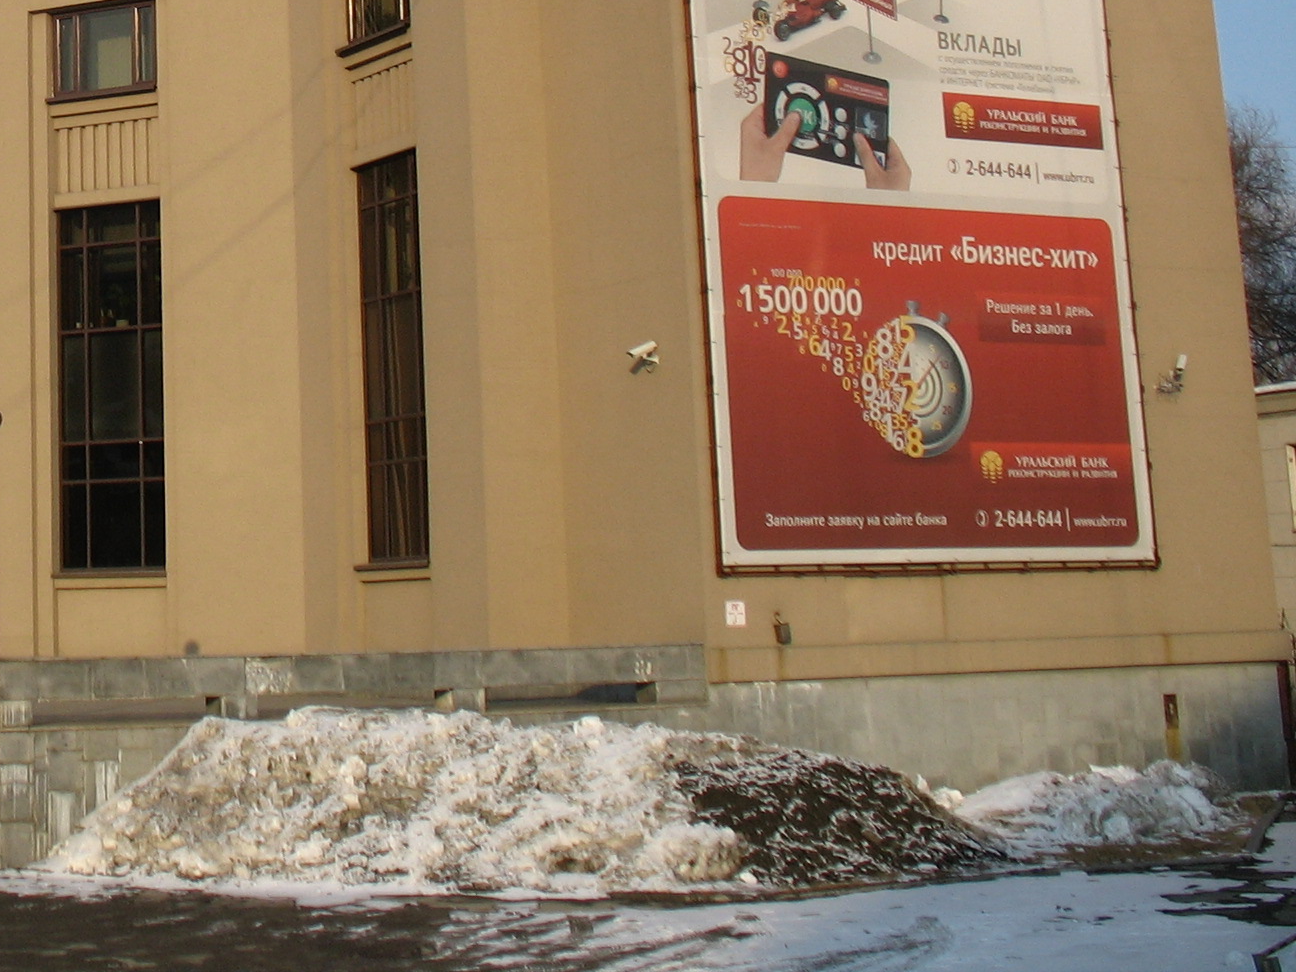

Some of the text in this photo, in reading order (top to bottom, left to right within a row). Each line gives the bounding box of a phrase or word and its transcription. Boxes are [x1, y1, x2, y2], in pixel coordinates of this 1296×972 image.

[937, 31, 1022, 57] ВКЛАДЫ
[986, 108, 1078, 127] УРАЛЬСКИЙ БАНК
[965, 159, 1032, 179] 2-644-644
[872, 236, 1099, 270] кредит «Бизнес-хит»
[986, 299, 1037, 315] Решение
[1039, 304, 1052, 316] за
[1055, 303, 1062, 316] 1
[1011, 319, 1072, 336] Без залога
[1081, 456, 1109, 468] БАНК
[765, 512, 948, 530] Заполните заявку на сайте банка
[994, 510, 1062, 528] 2-644-644
